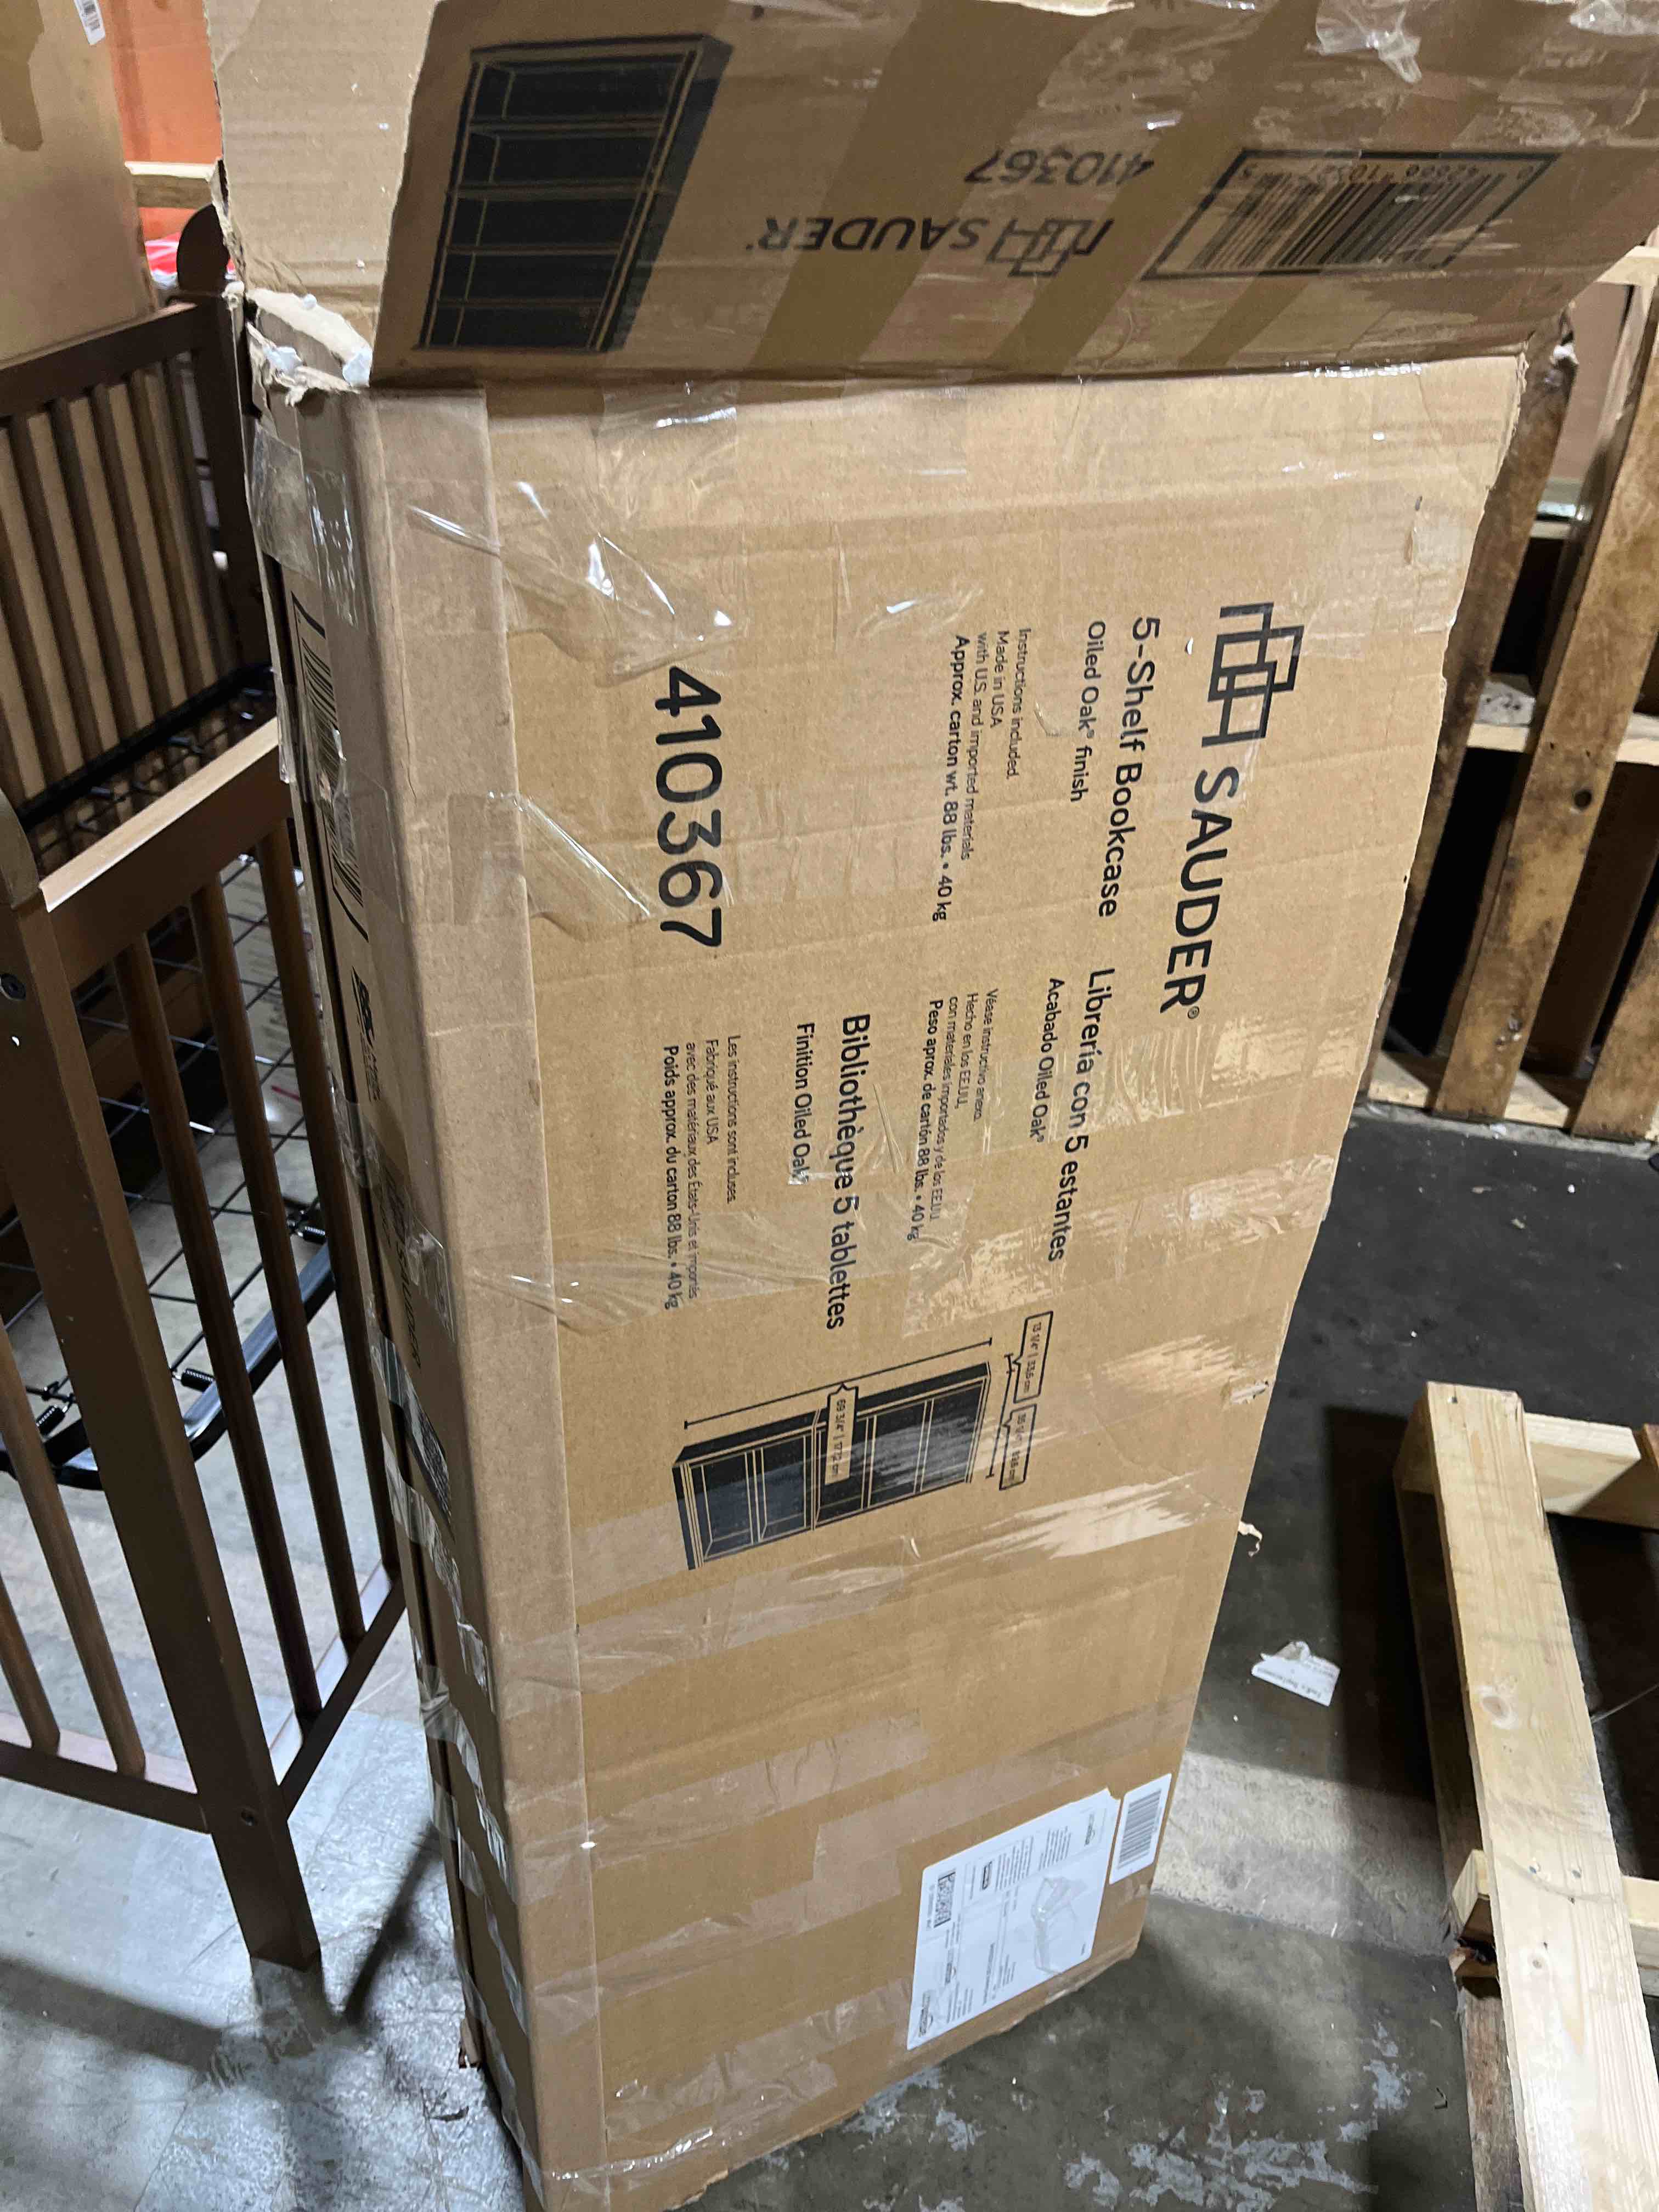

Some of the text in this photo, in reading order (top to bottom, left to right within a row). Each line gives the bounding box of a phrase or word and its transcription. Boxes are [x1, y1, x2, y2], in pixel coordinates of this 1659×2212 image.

[963, 149, 1154, 186] 410367
[973, 633, 989, 668] with
[989, 630, 1009, 729] Made in USA
[1082, 621, 1105, 680] Oiled
[969, 698, 984, 726] and
[1005, 628, 1030, 780] Instructions included.
[930, 635, 970, 922] Approx. carton wt. 88 lbs. 40 kg
[963, 730, 983, 795] imported
[1069, 746, 1093, 803] finish
[1097, 616, 1160, 918] 5-Shelf Bookcase
[653, 665, 724, 947] 410367
[958, 798, 977, 861] materials
[946, 996, 958, 1018] con
[962, 992, 978, 1031] Hecho
[983, 988, 998, 1025] Véase
[1039, 978, 1065, 1053] Acabado
[685, 1042, 697, 1071] avec
[726, 1035, 741, 1057] Les
[791, 1023, 816, 1091] Finition
[940, 1020, 959, 1081] materiales
[959, 1051, 972, 1068] los
[961, 1034, 972, 1048] en
[975, 1027, 993, 1085] instructivo
[685, 1074, 698, 1096] des
[703, 1039, 718, 1144] Fabriqué aux USA
[726, 1060, 740, 1128] instructions
[1033, 1057, 1055, 1101] Oiled
[686, 1098, 699, 1156] matériaux
[726, 1130, 738, 1155] sont
[790, 1094, 814, 1140] Oiled
[906, 1000, 943, 1241] Peso aprox. de cartón 88 lbs. 40 kg
[934, 1084, 953, 1144] importados
[1046, 968, 1115, 1263] Librería con 5 estantes
[661, 1045, 683, 1310] Poids approx. du carton 88 lbs. 40 kg
[686, 1158, 699, 1180] des
[823, 1014, 871, 1330] Bibliothèque 5 tablettes
[933, 1145, 943, 1154] y
[933, 1155, 946, 1170] de
[932, 1171, 945, 1187] los
